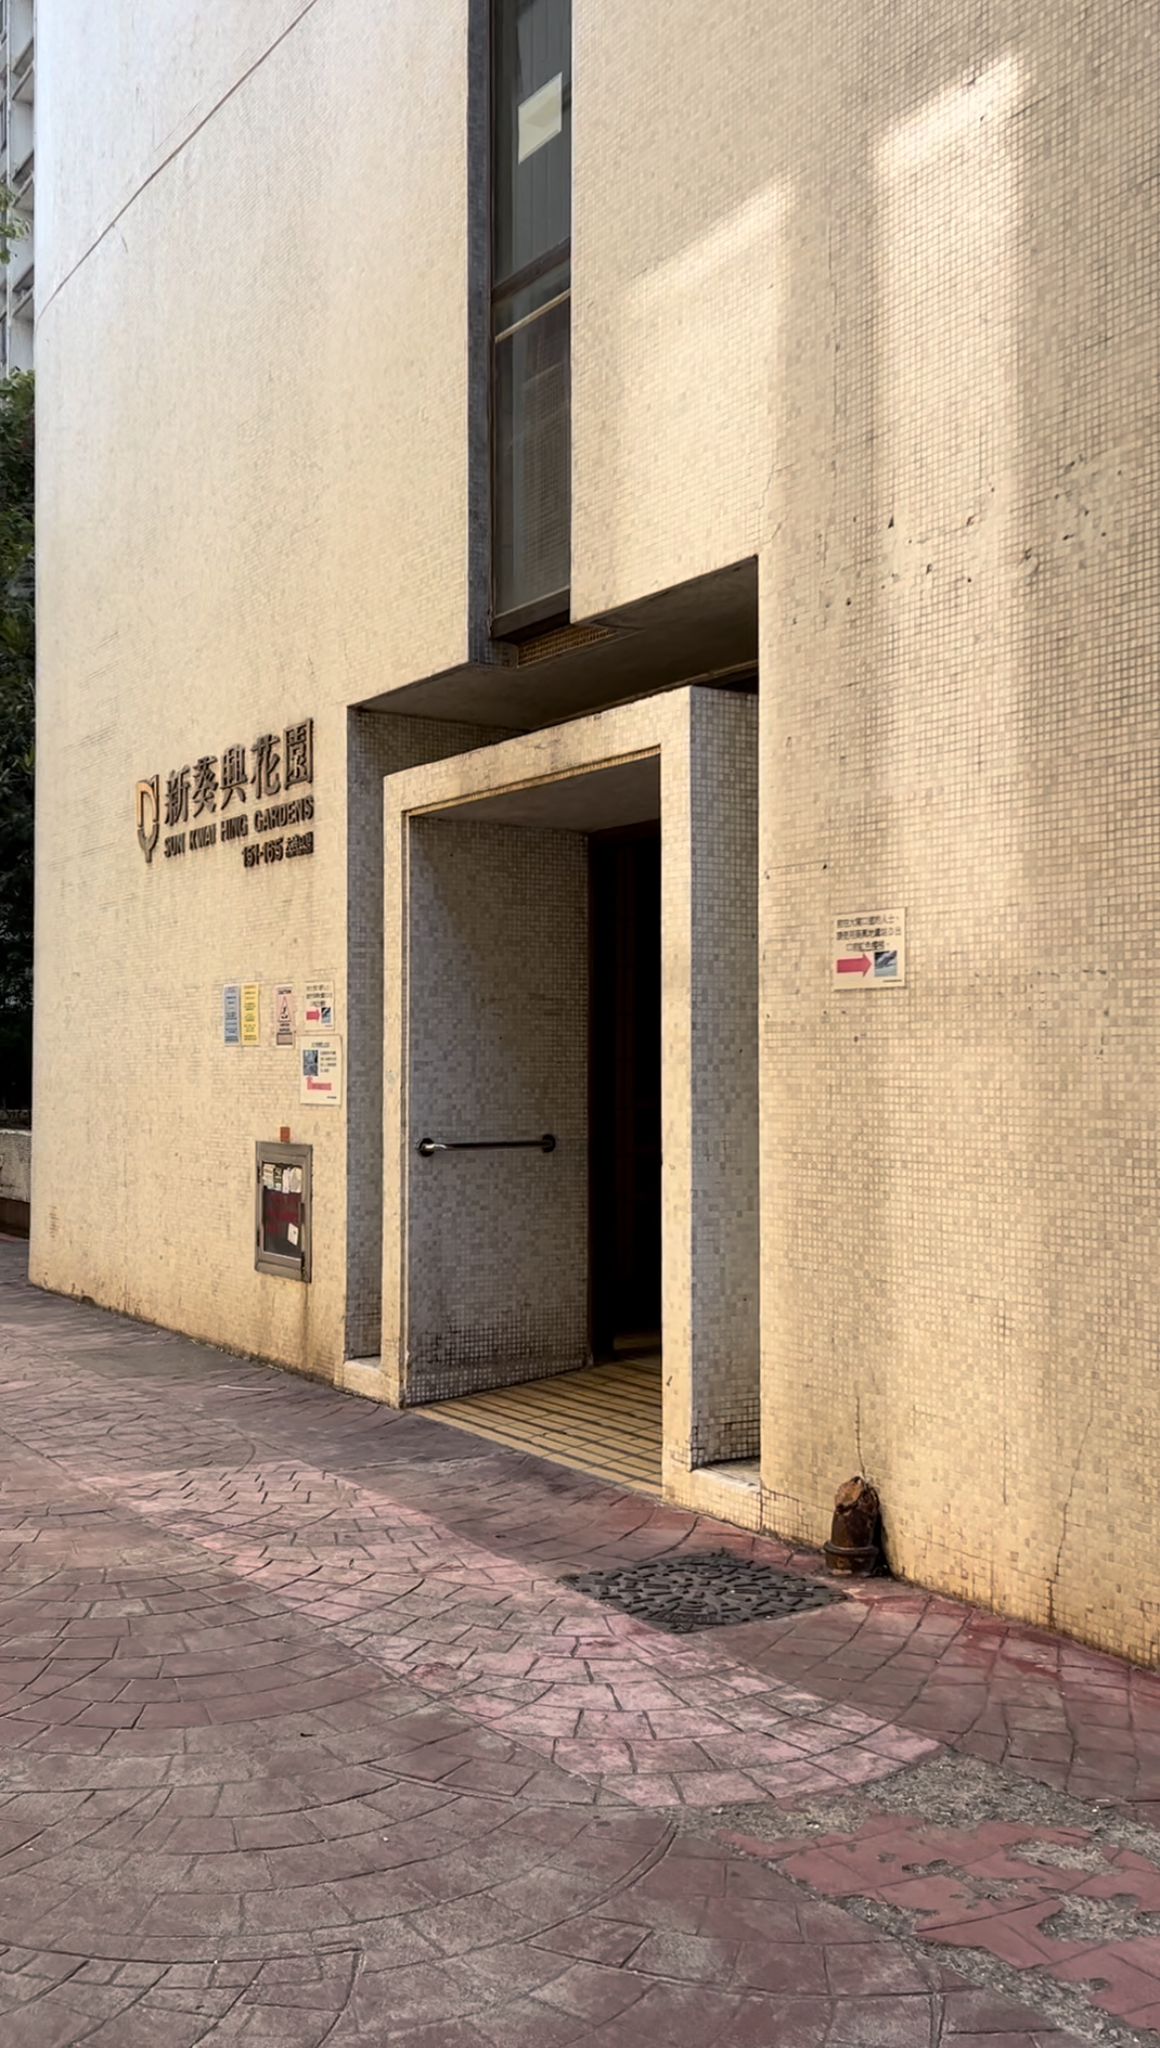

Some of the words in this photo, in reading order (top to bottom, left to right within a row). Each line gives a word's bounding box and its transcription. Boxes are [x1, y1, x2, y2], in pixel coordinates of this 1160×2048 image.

[164, 717, 315, 827] 新葵興花園
[164, 831, 186, 858] SUN
[189, 823, 216, 851] KWAI
[220, 814, 249, 842] HING
[254, 794, 315, 833] GARDENS
